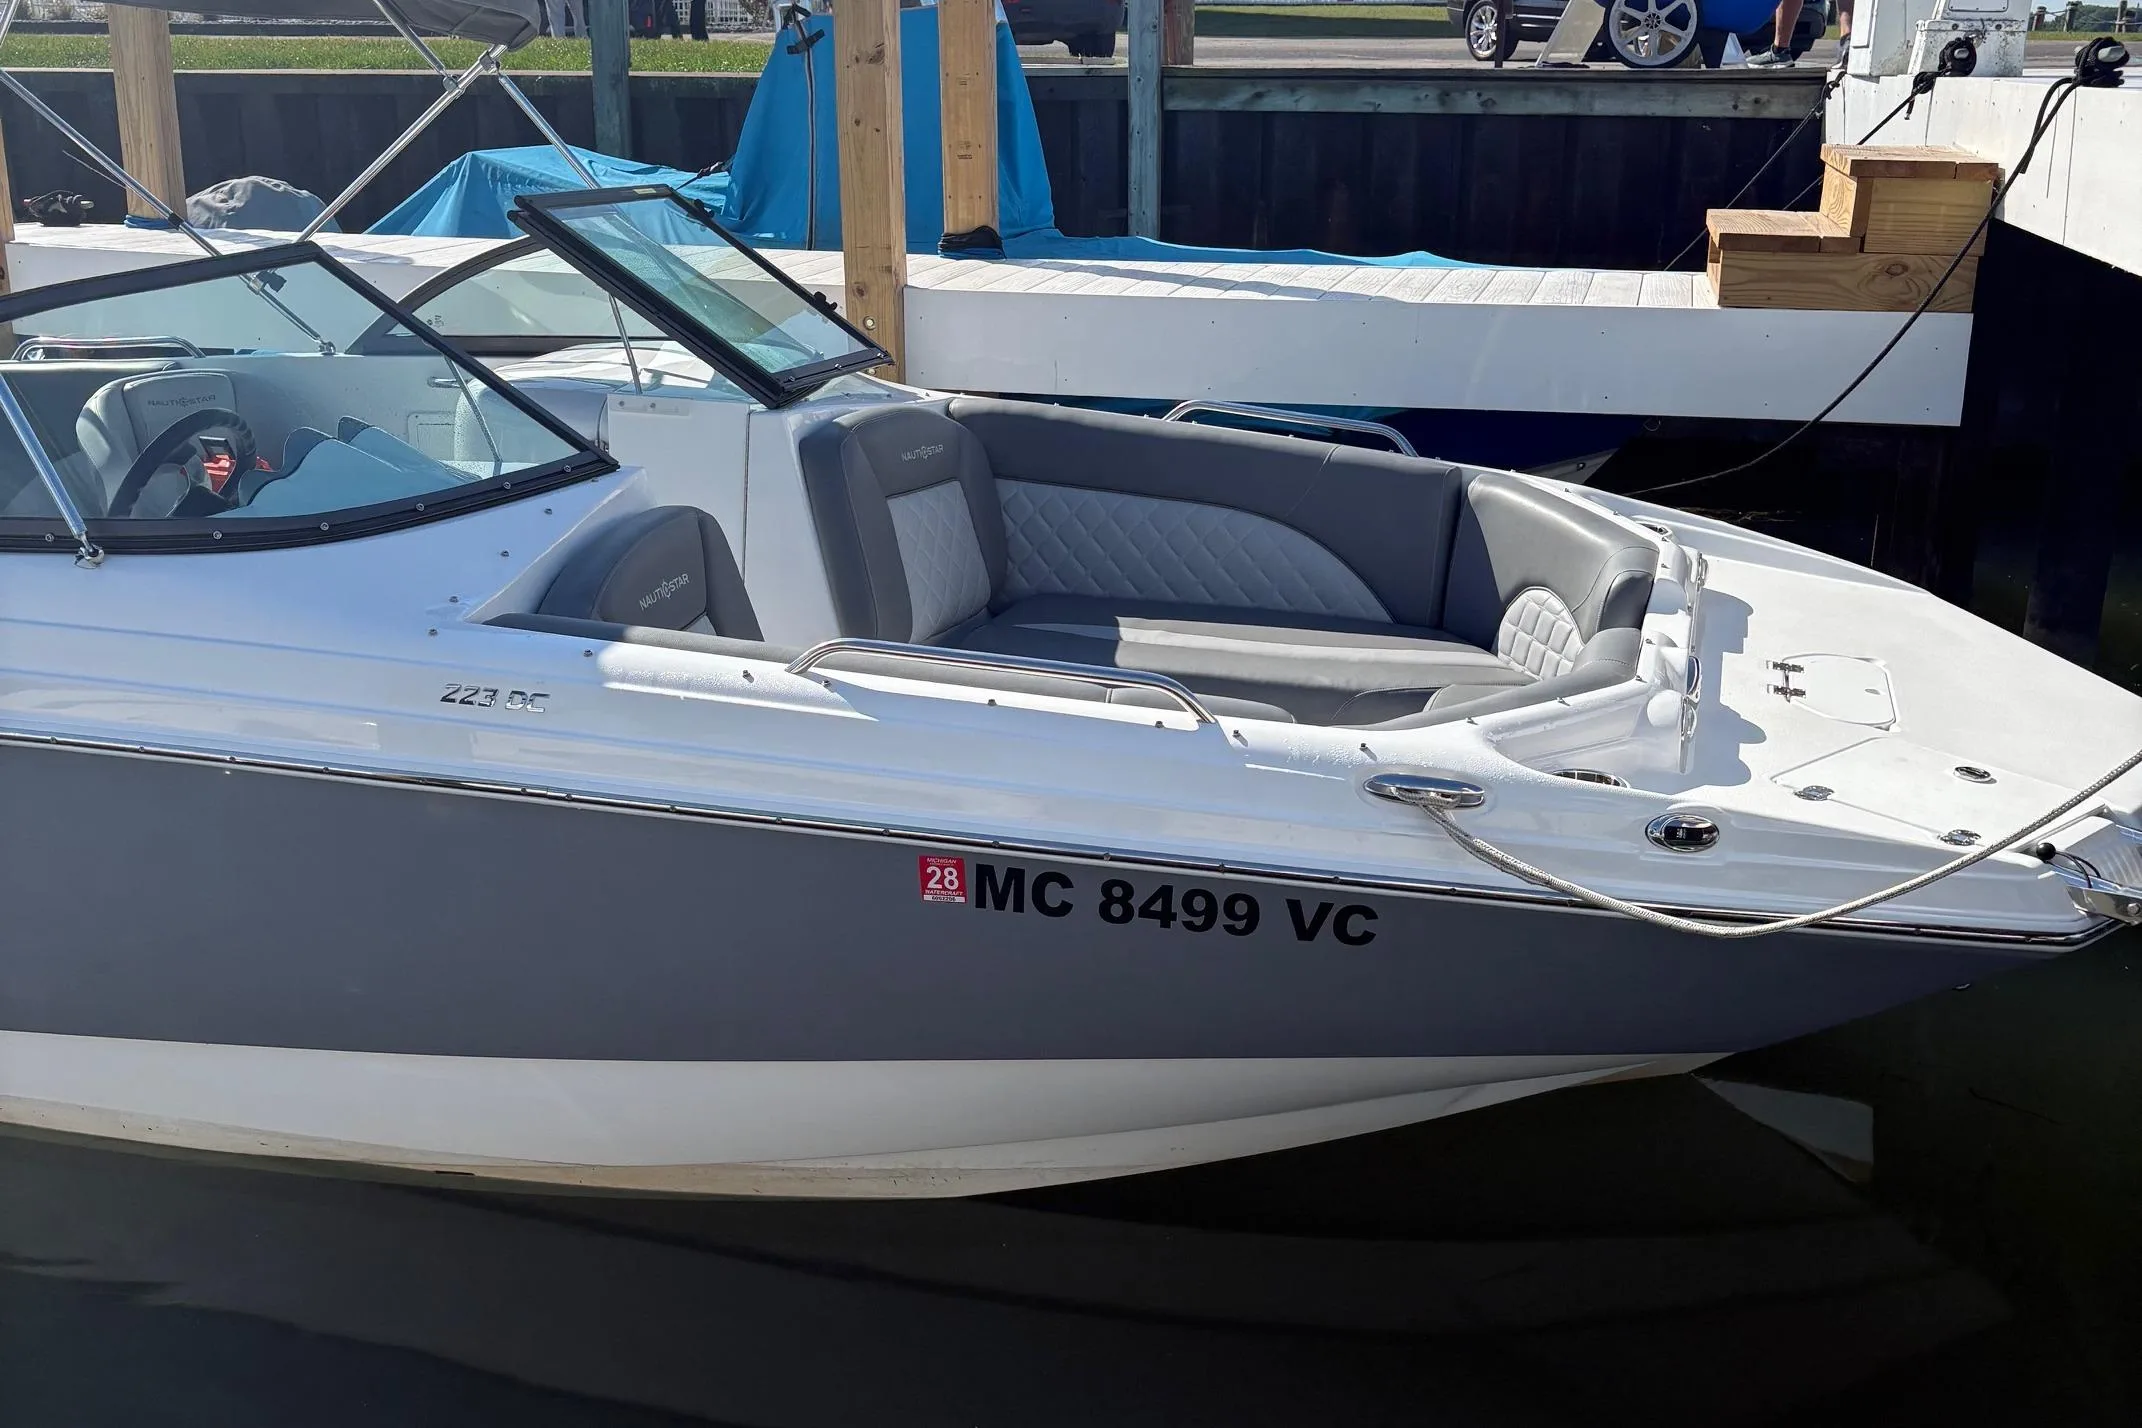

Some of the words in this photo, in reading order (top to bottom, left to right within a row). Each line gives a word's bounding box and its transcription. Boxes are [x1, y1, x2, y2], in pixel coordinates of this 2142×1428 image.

[440, 683, 499, 708] 223
[505, 690, 551, 713] DC
[926, 865, 959, 890] 28
[974, 863, 1074, 918] MC
[1098, 878, 1261, 937] 8499
[1285, 898, 1379, 946] VC
